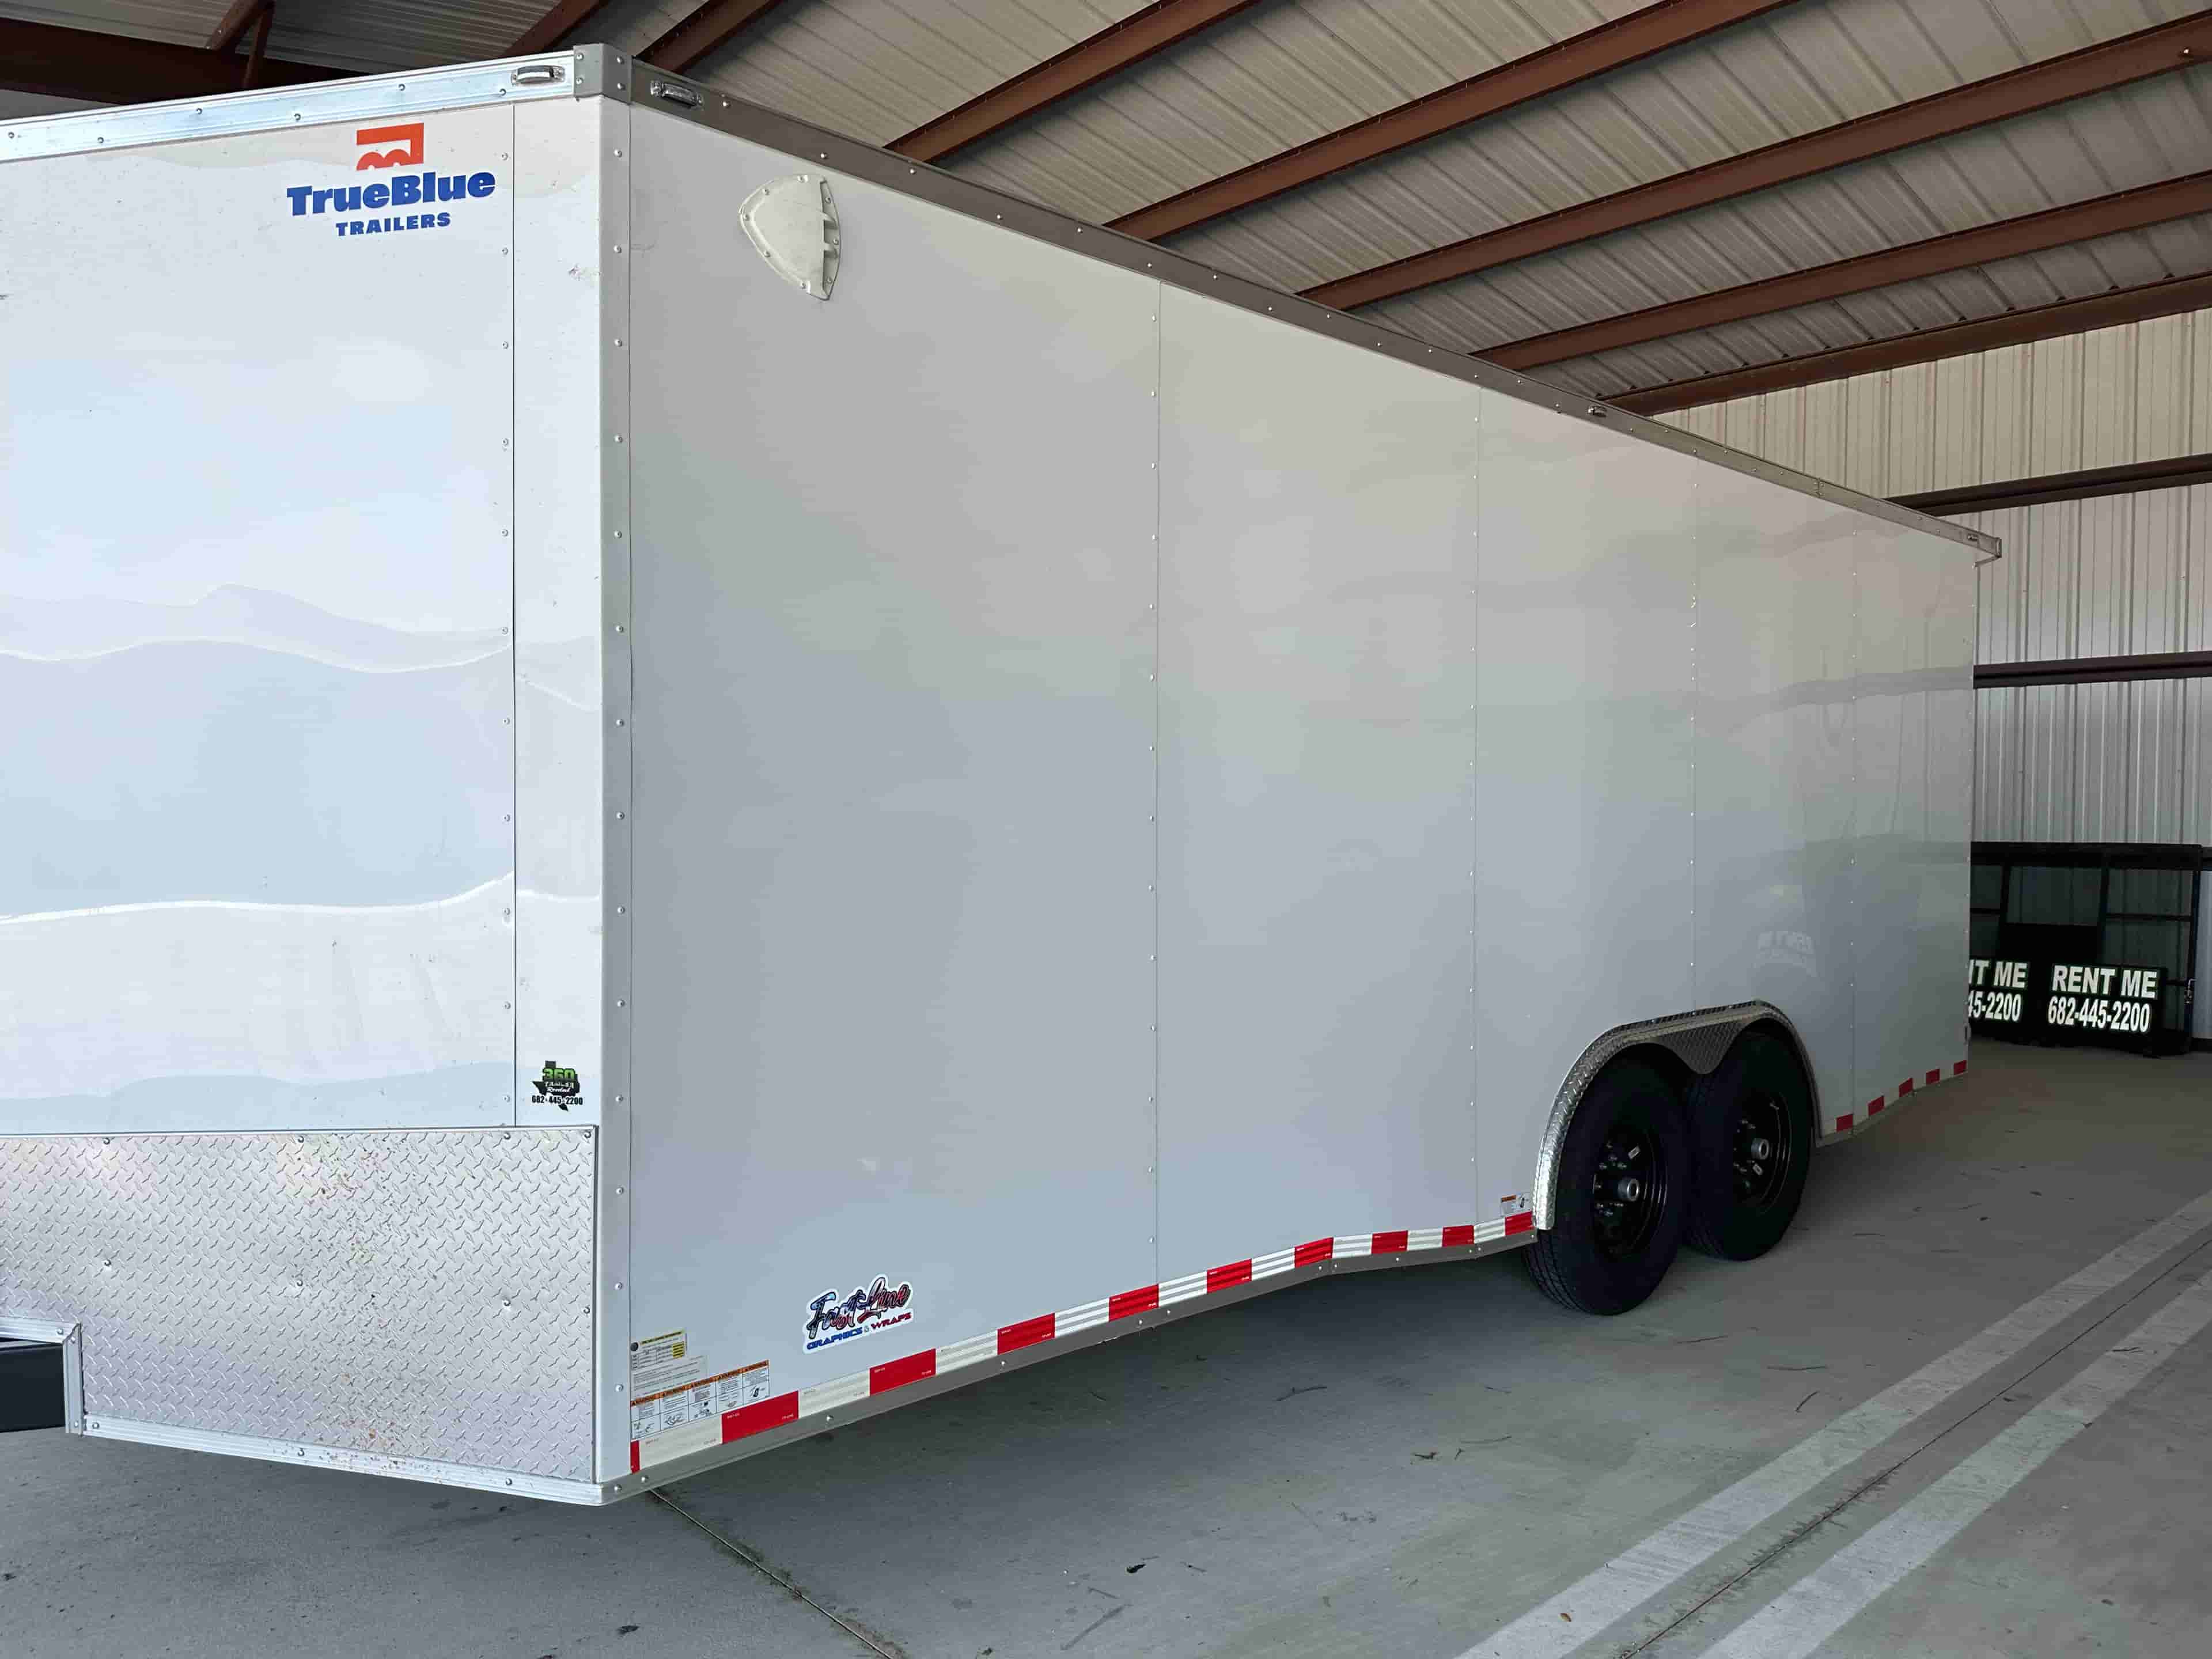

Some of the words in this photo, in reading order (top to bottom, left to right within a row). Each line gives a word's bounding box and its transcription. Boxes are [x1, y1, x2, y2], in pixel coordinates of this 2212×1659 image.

[287, 172, 495, 216] TrueBlue
[336, 213, 451, 236] TRAILERS
[1994, 961, 2027, 988] ME
[2052, 965, 2116, 995] RENT
[2121, 970, 2157, 999] ME
[2048, 996, 2151, 1033] 682-445-2200
[806, 1327, 862, 1350] GRAPHICS
[870, 1312, 912, 1330] WRAPS
